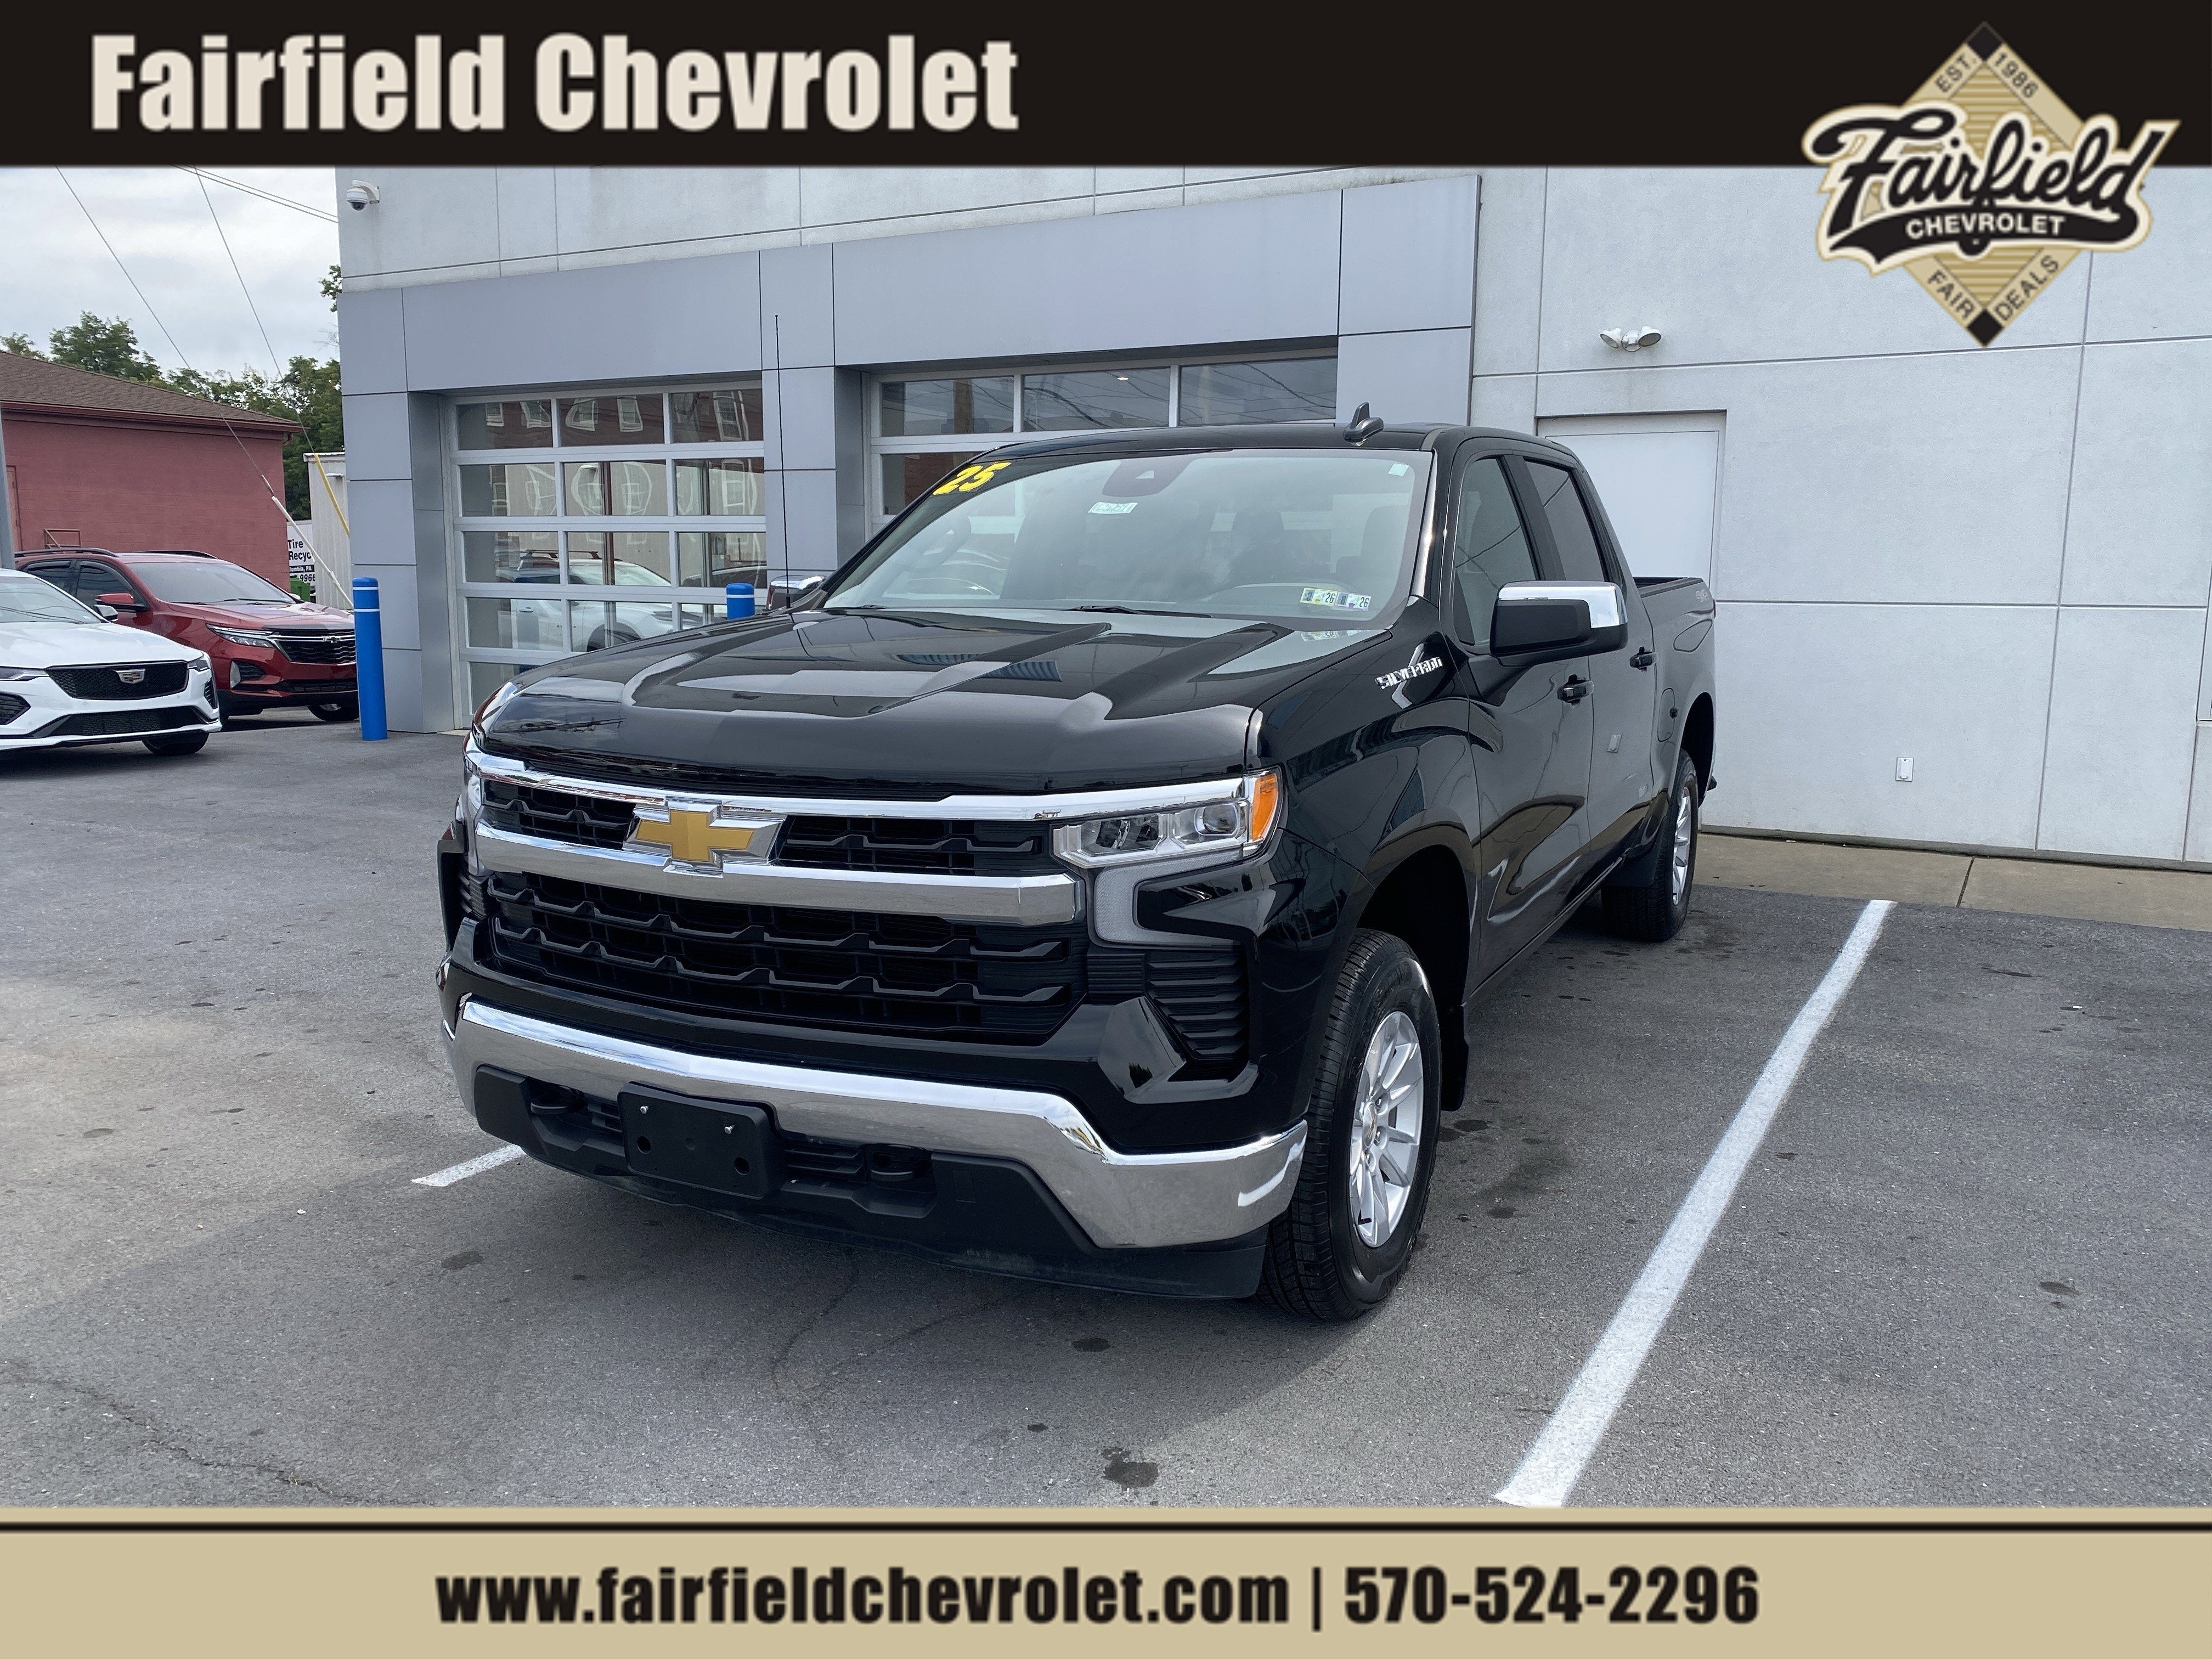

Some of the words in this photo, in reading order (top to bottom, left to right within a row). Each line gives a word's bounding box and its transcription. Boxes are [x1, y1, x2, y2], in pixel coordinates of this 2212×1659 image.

[933, 461, 1012, 495] 25
[288, 539, 303, 549] Tire
[289, 551, 313, 562] Recyc
[1325, 592, 1335, 603] 26
[1359, 596, 1369, 608] 26
